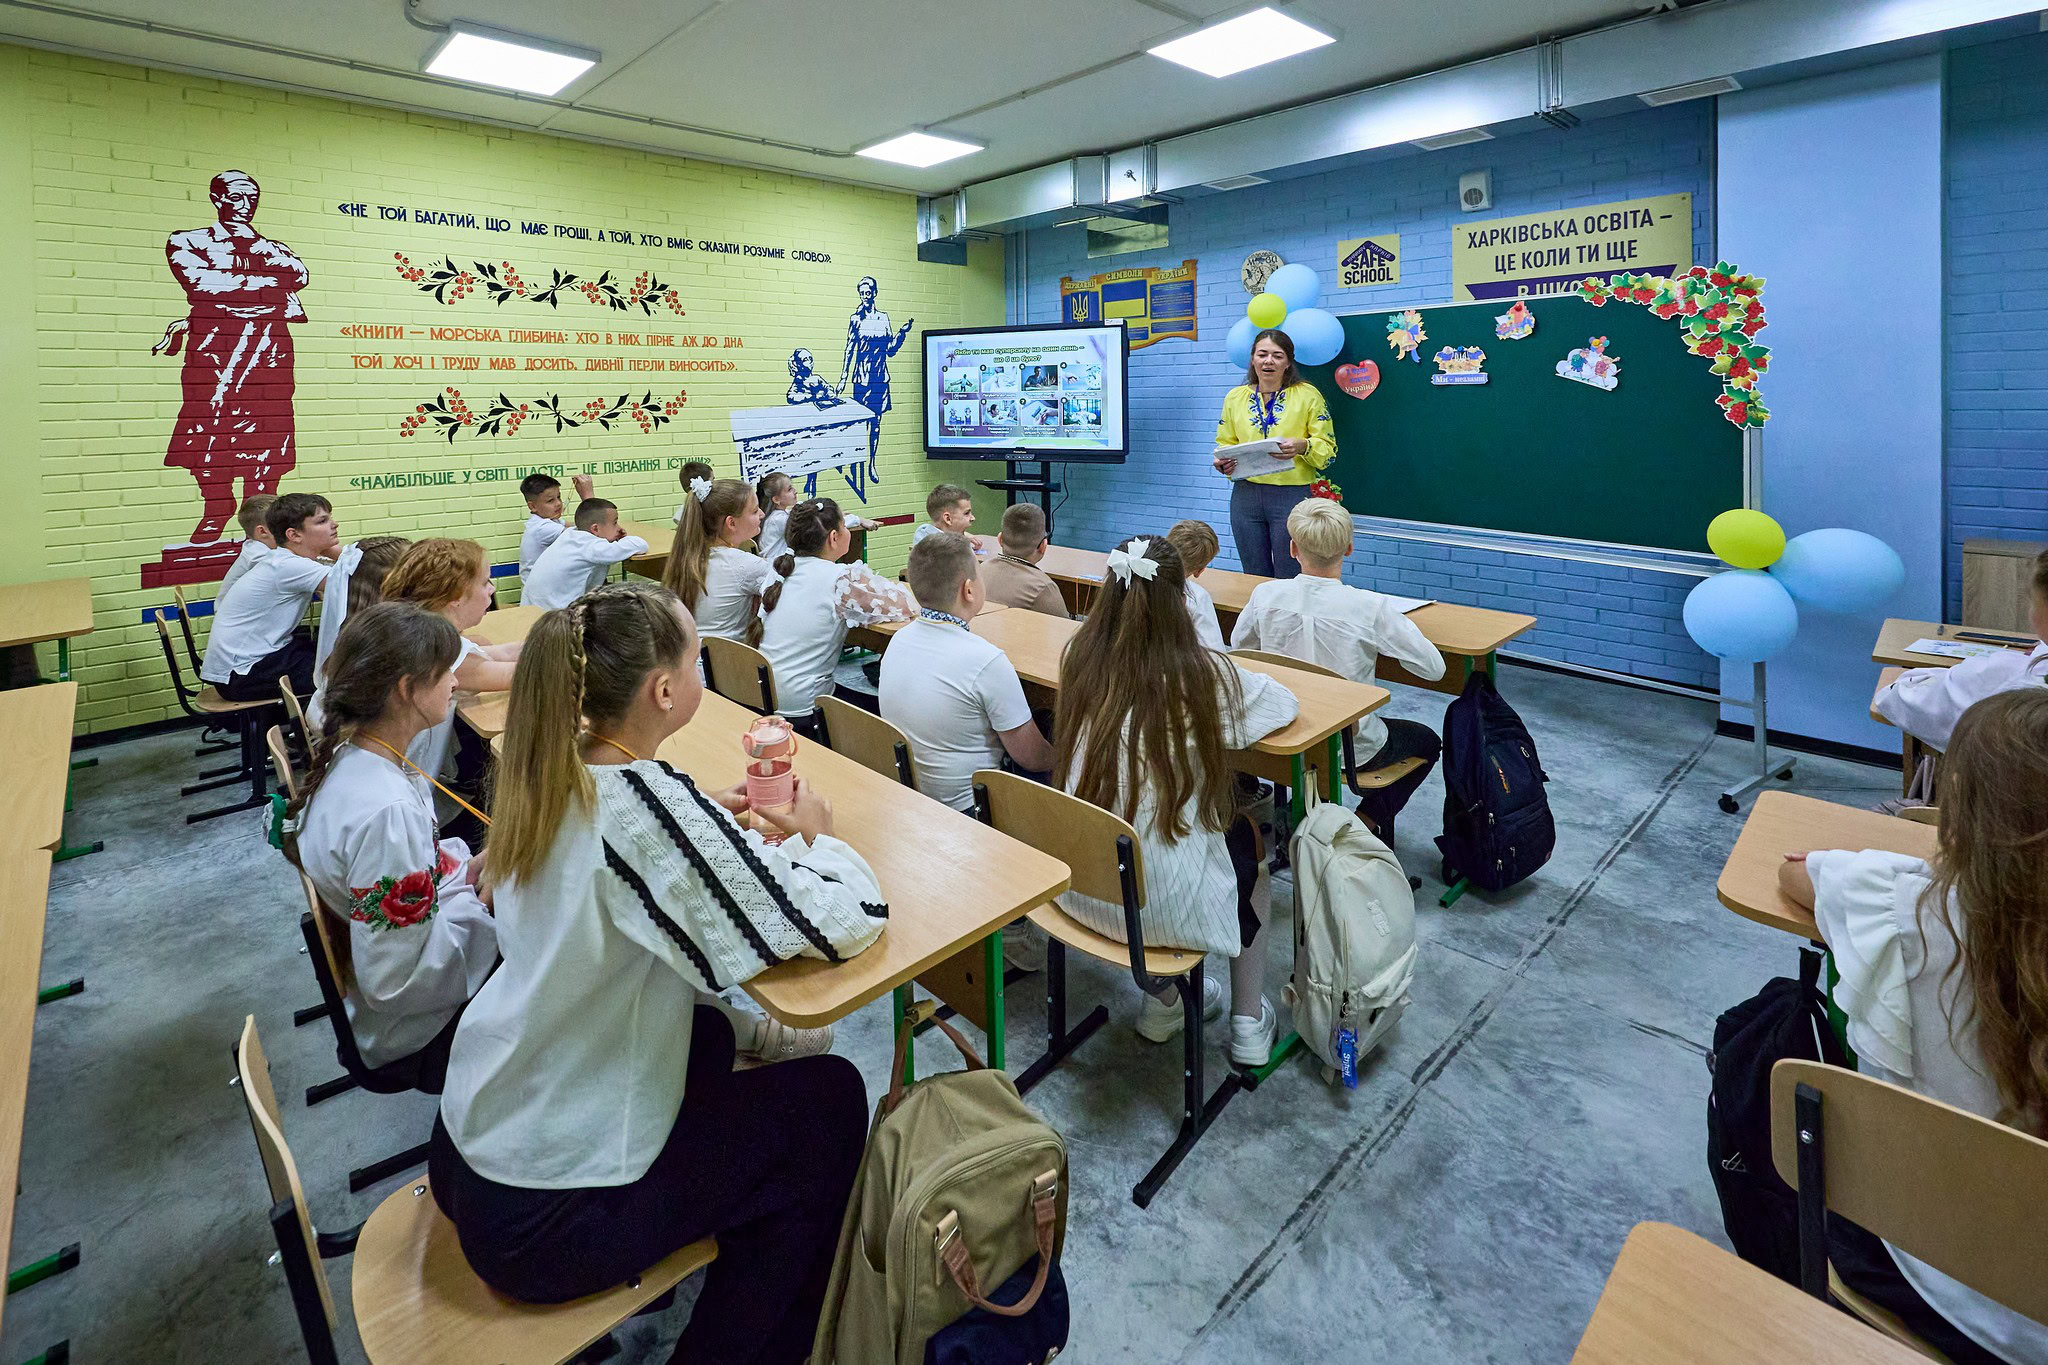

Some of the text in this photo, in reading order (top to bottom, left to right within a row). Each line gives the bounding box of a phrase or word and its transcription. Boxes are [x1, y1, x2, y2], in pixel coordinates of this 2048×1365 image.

[338, 203, 368, 218] «НЕ
[377, 205, 407, 222] ТОЙ
[485, 217, 511, 232] ЩО
[521, 221, 548, 236] МАЄ
[597, 229, 606, 242] А
[640, 233, 663, 248] ХТО
[667, 237, 694, 250] ВМІЄ
[698, 240, 740, 256] СКАЗАТИ
[743, 245, 785, 260] РОЗУМНЕ
[1467, 219, 1578, 249] ХАРКІВСЬКА
[1584, 208, 1654, 234] ОСВІТА
[1350, 248, 1386, 269] SAFE
[1495, 239, 1638, 275] ЦЕ КОЛИ ТИ ЩЕ
[1105, 269, 1143, 281] СИМВОЛИ
[1157, 267, 1188, 280] УКРАЇНИ
[1344, 267, 1394, 285] SCHOOL
[339, 325, 404, 340] «КНИГИ
[430, 327, 502, 342] МОРСЬКА
[509, 330, 568, 344] ГЛИБИНА:
[576, 332, 599, 345] ХТО
[606, 333, 613, 345] В
[618, 334, 641, 346] НИХ
[646, 334, 675, 347] ПІРНЕ
[682, 335, 698, 347] АЖ
[702, 336, 718, 348] ДО
[724, 337, 744, 348] ДНА
[351, 353, 383, 369] ТОЙ
[393, 355, 423, 369] ХОЧ
[430, 356, 436, 369] І
[442, 356, 481, 371] ТРУДУ
[489, 357, 516, 370] МАВ
[585, 357, 624, 371] ДИВНІЇ
[629, 359, 665, 371] ПЕРЛИ
[670, 360, 738, 372] ВИНОСИТЬ».
[1345, 382, 1376, 394] Україна!
[1436, 375, 1448, 383] Ми
[350, 471, 456, 490] «НАЙБІЛЬШЕ
[463, 470, 472, 483] У
[476, 468, 509, 482] СВІТІ
[583, 463, 597, 475] ЦЕ
[603, 458, 660, 474] ПІЗНАННЯ
